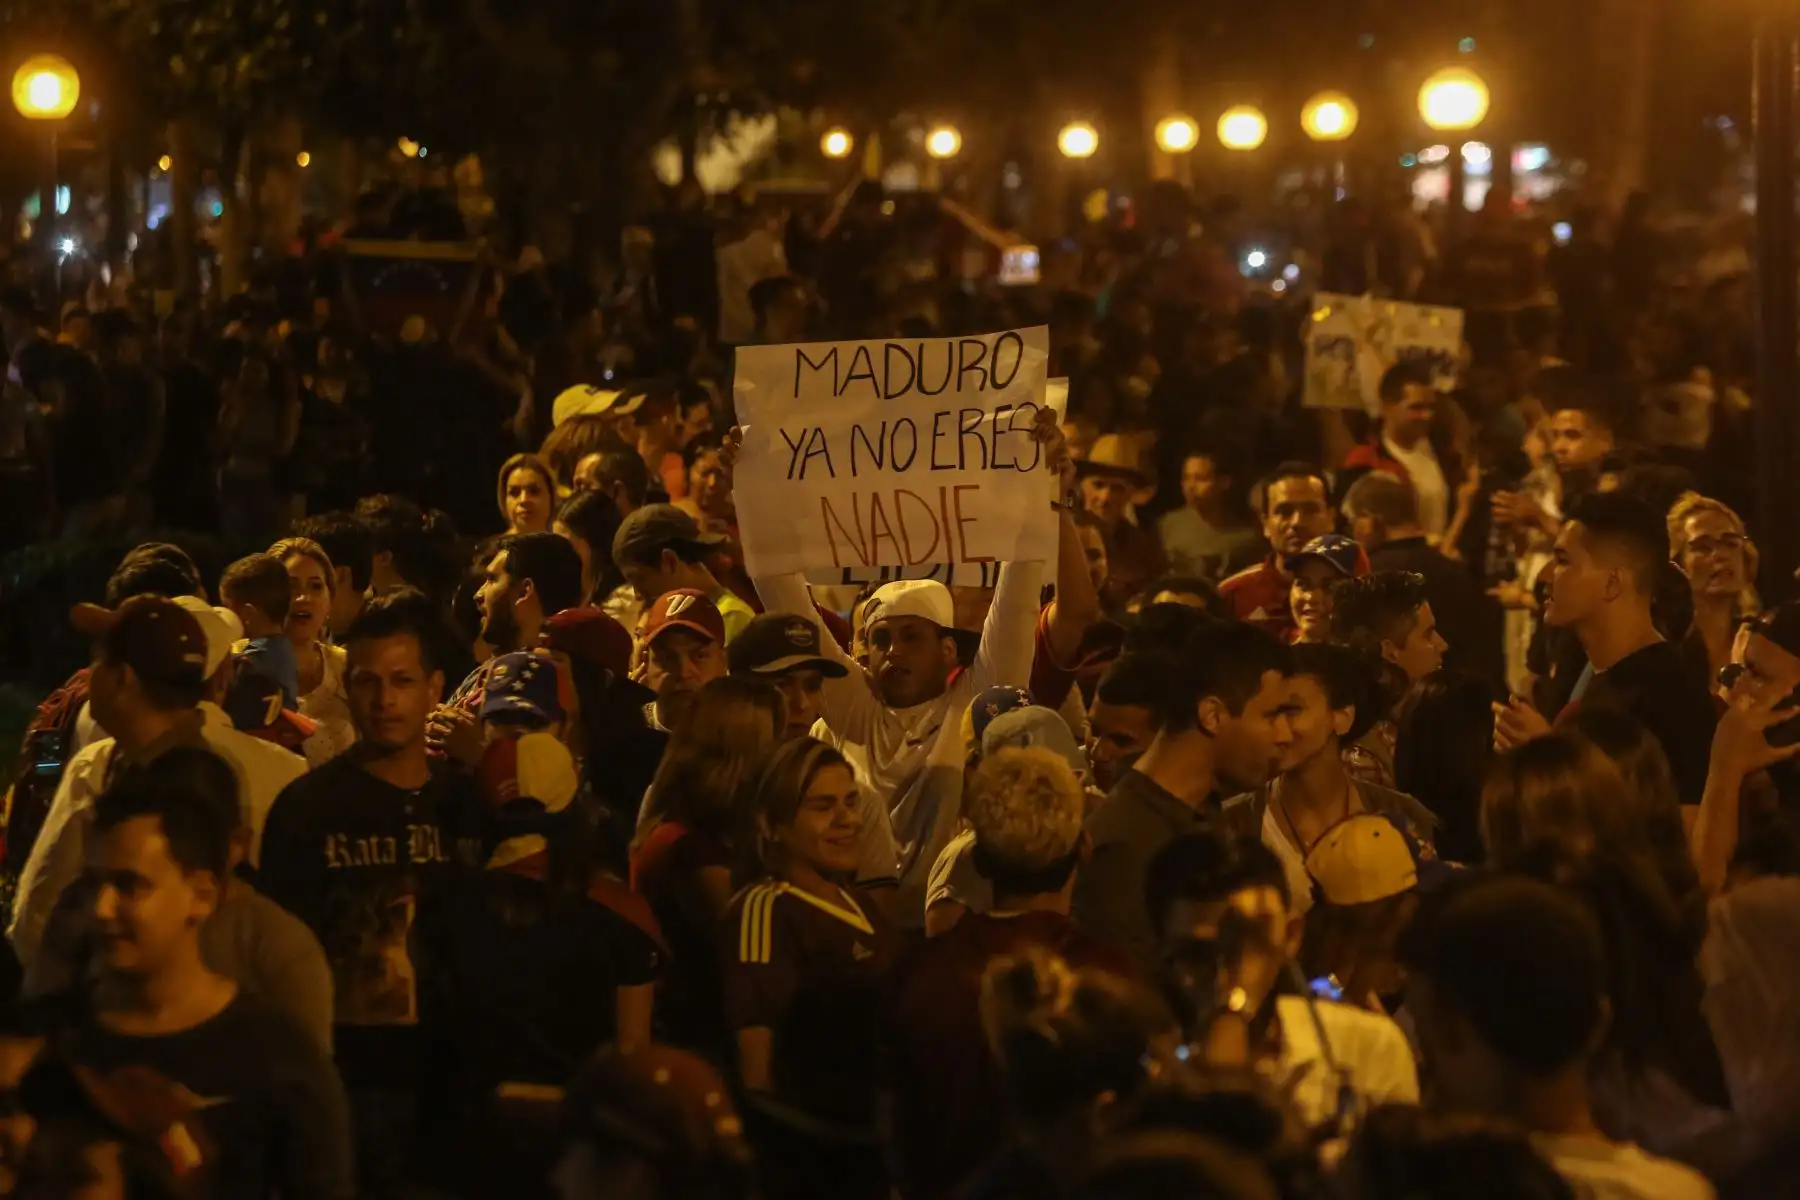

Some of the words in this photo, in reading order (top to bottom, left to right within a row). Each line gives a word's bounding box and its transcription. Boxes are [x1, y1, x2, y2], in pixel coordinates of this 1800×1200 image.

[794, 331, 1024, 400] MADURO
[779, 427, 836, 480] YA
[851, 418, 918, 477] NO
[931, 401, 1041, 472] ERES
[820, 484, 996, 568] NADIE
